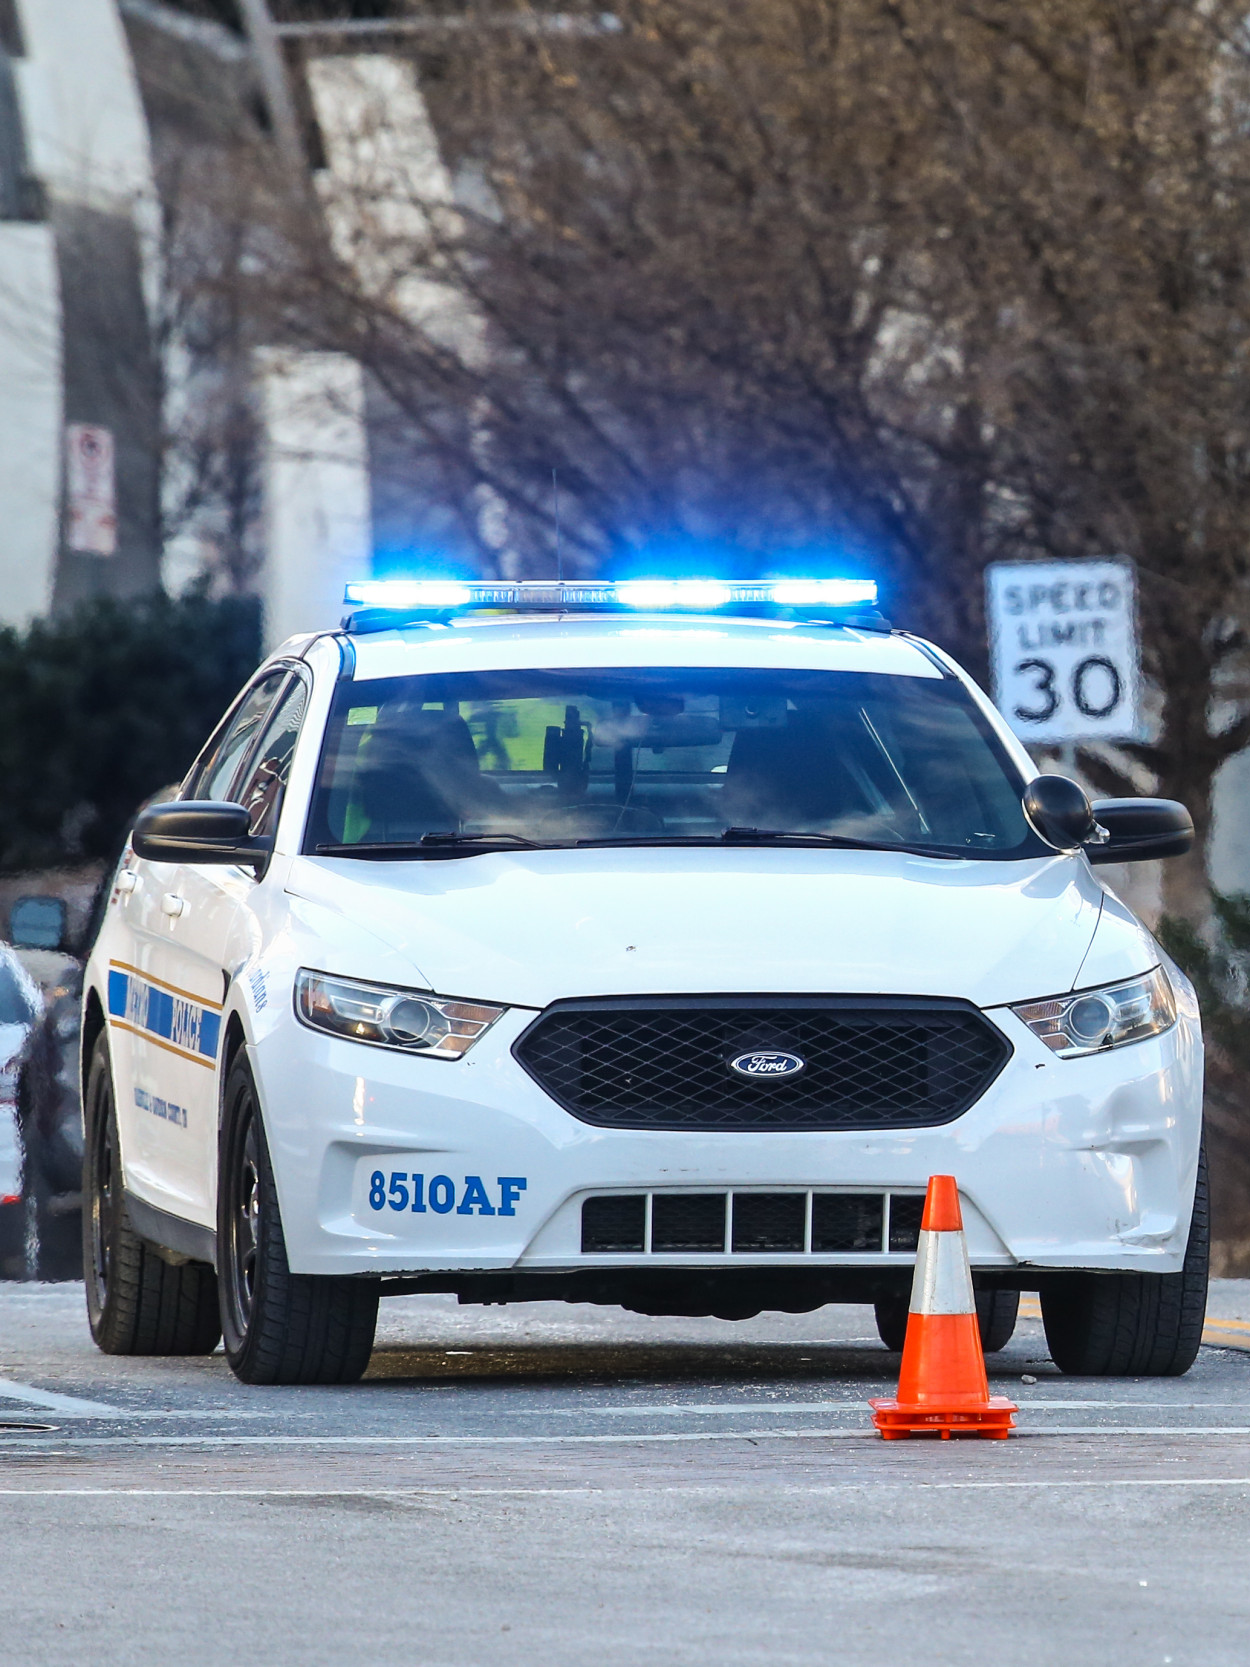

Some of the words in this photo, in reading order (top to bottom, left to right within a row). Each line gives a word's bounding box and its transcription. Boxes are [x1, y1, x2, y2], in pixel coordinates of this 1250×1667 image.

[1004, 581, 1120, 615] SPEED
[1017, 618, 1105, 649] LIMIT
[1015, 656, 1121, 723] 30
[170, 998, 203, 1053] POLICE
[747, 1055, 788, 1072] Ford
[369, 1170, 527, 1216] 8510AF
